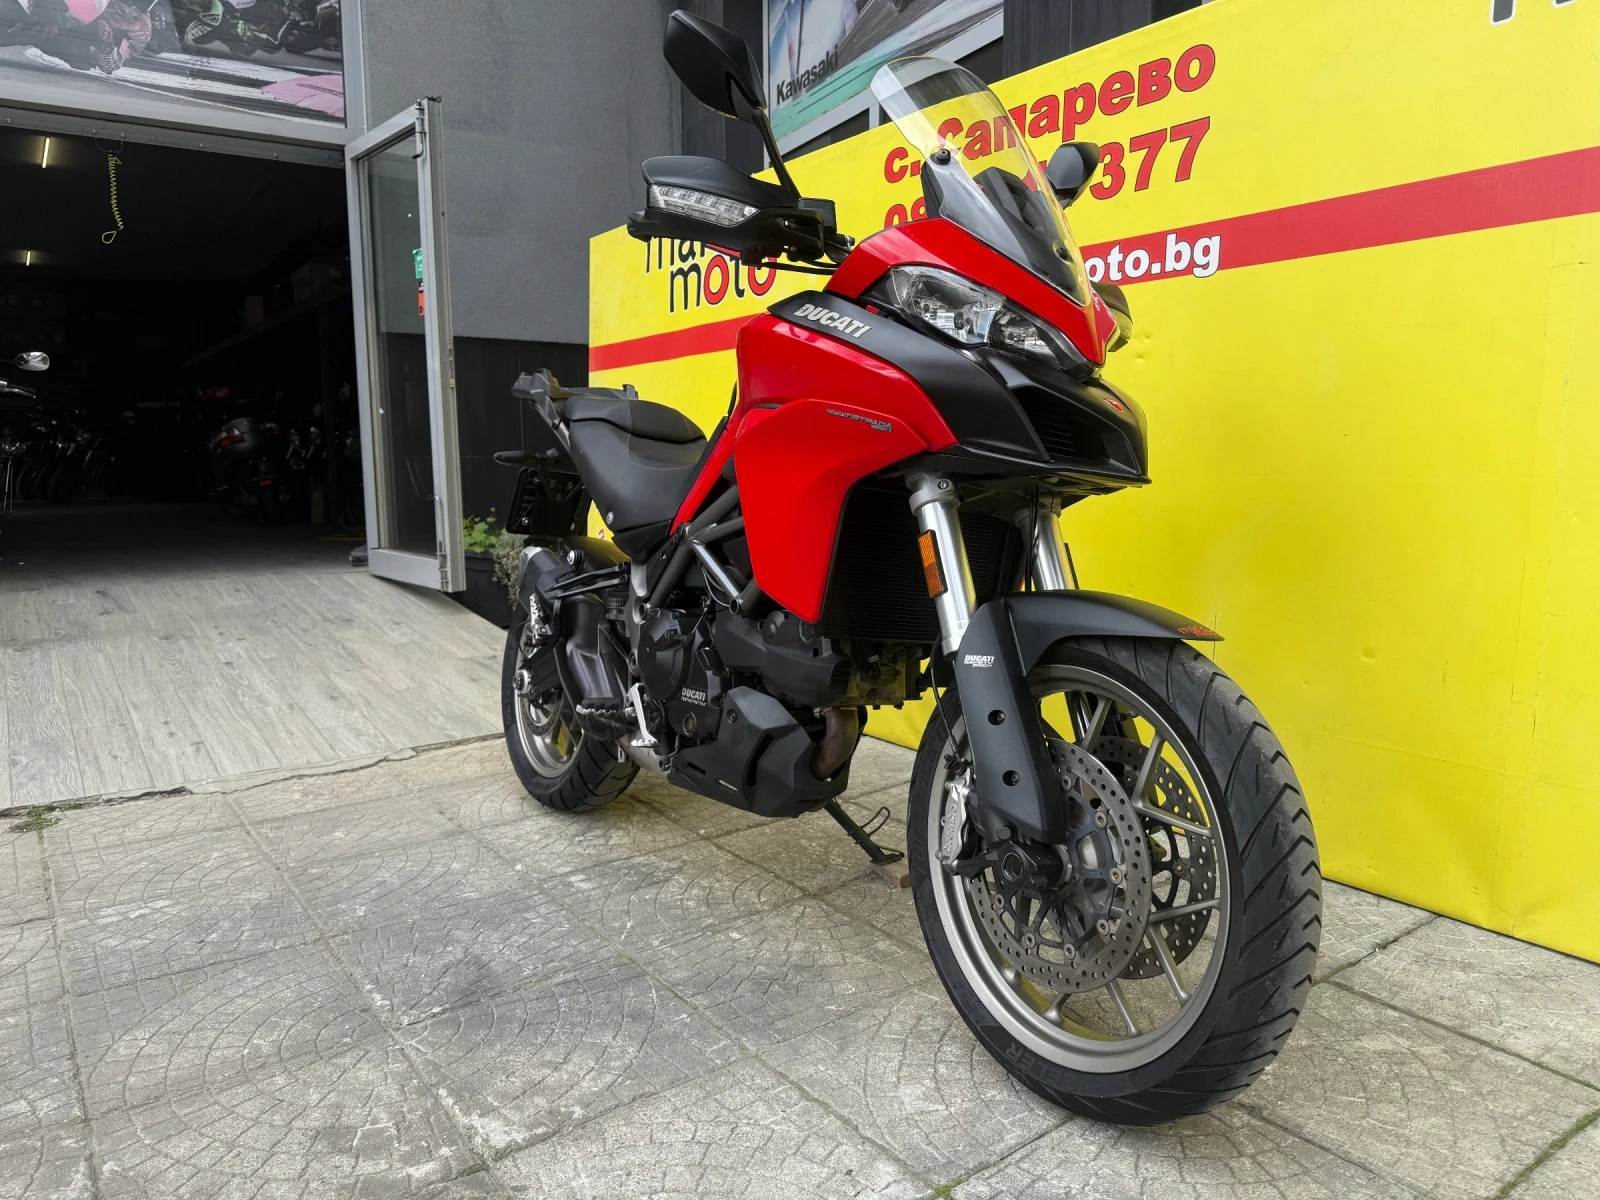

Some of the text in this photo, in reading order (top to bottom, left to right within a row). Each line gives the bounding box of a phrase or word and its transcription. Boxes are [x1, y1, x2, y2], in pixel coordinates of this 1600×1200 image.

[776, 44, 839, 106] Kawasaki
[669, 254, 778, 314] moto
[794, 303, 872, 339] DUCATI
[964, 654, 994, 662] DUCATI
[681, 687, 707, 702] DUCATI
